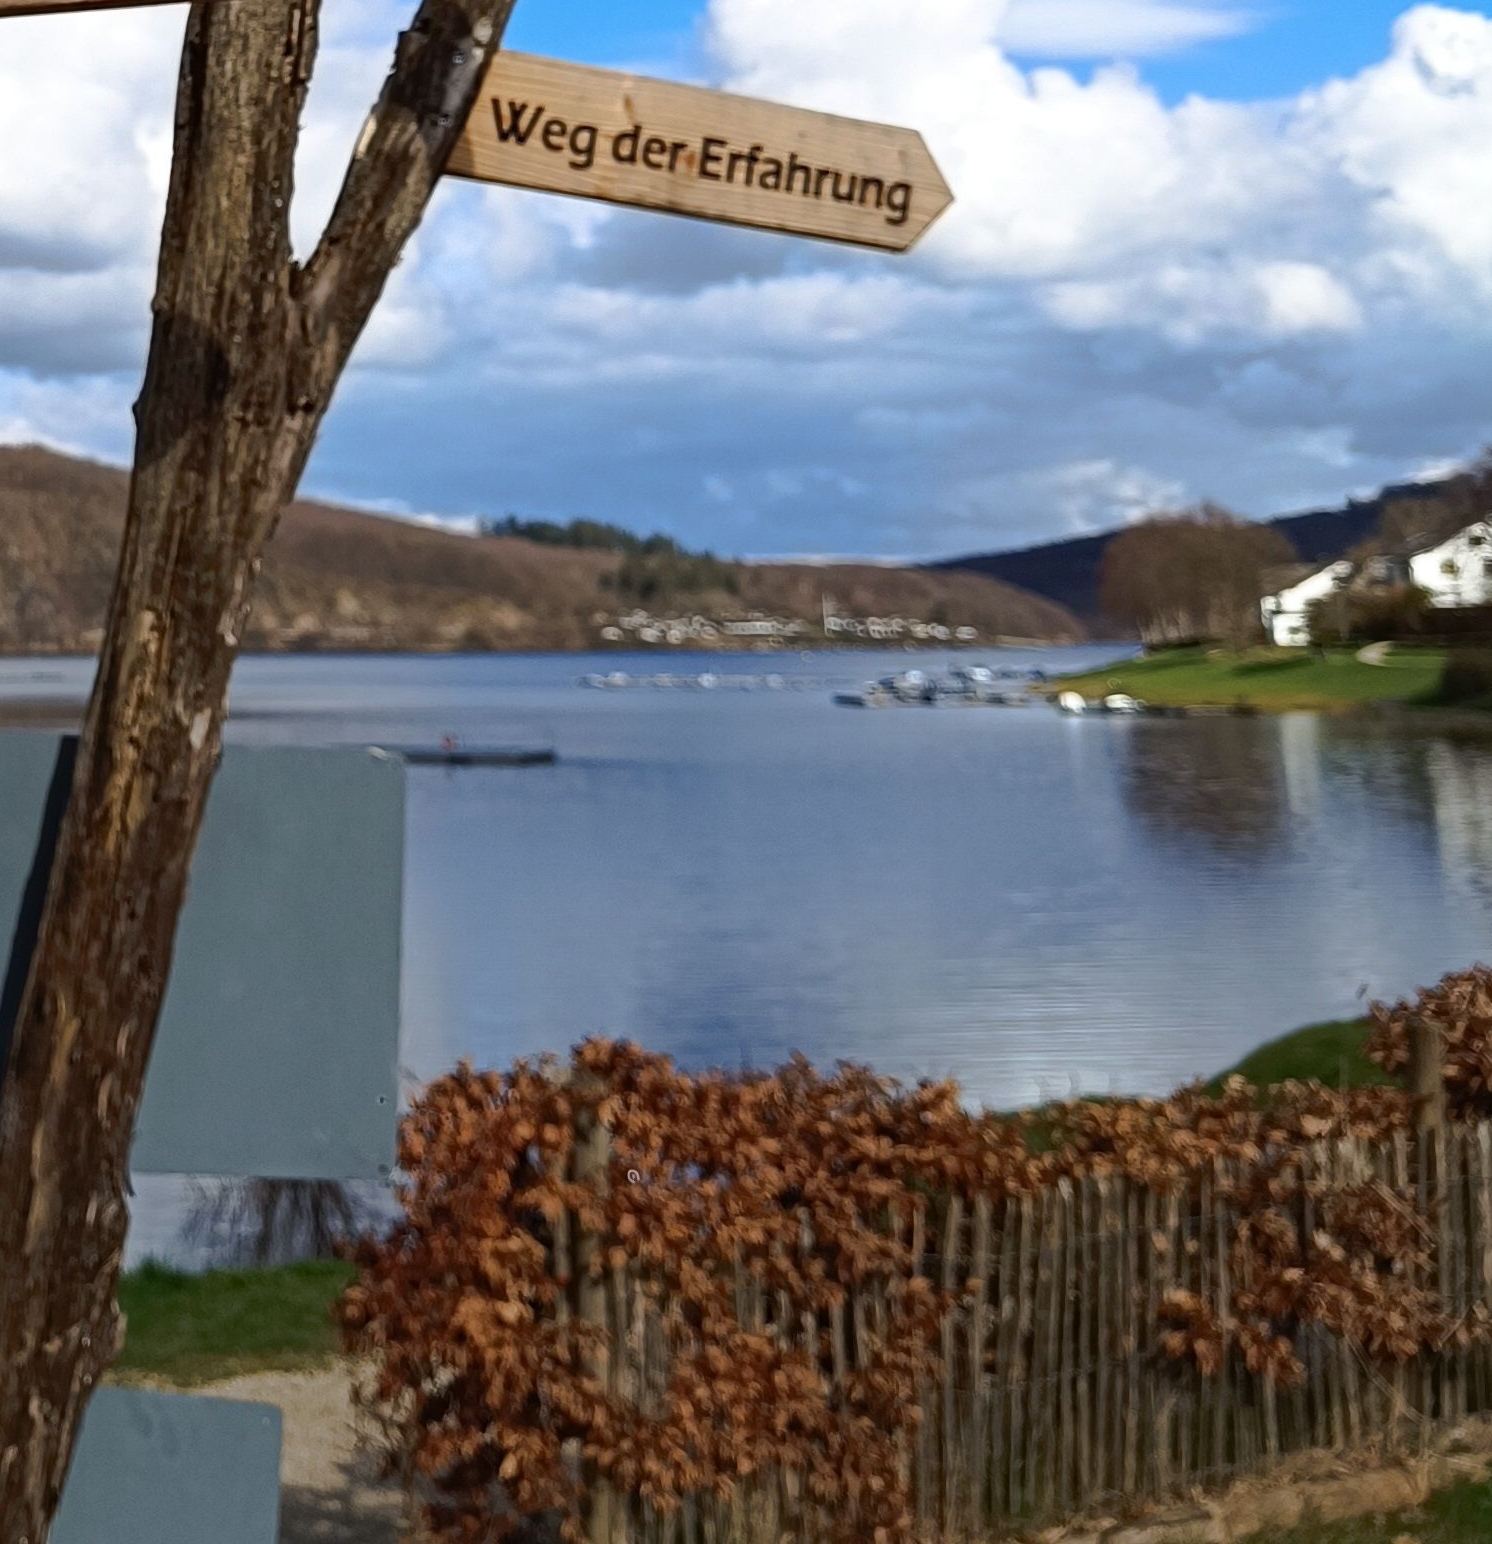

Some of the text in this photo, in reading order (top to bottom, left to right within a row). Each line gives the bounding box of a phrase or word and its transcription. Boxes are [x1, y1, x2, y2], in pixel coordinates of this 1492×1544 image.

[491, 97, 913, 226] Weg der Erfahrung
